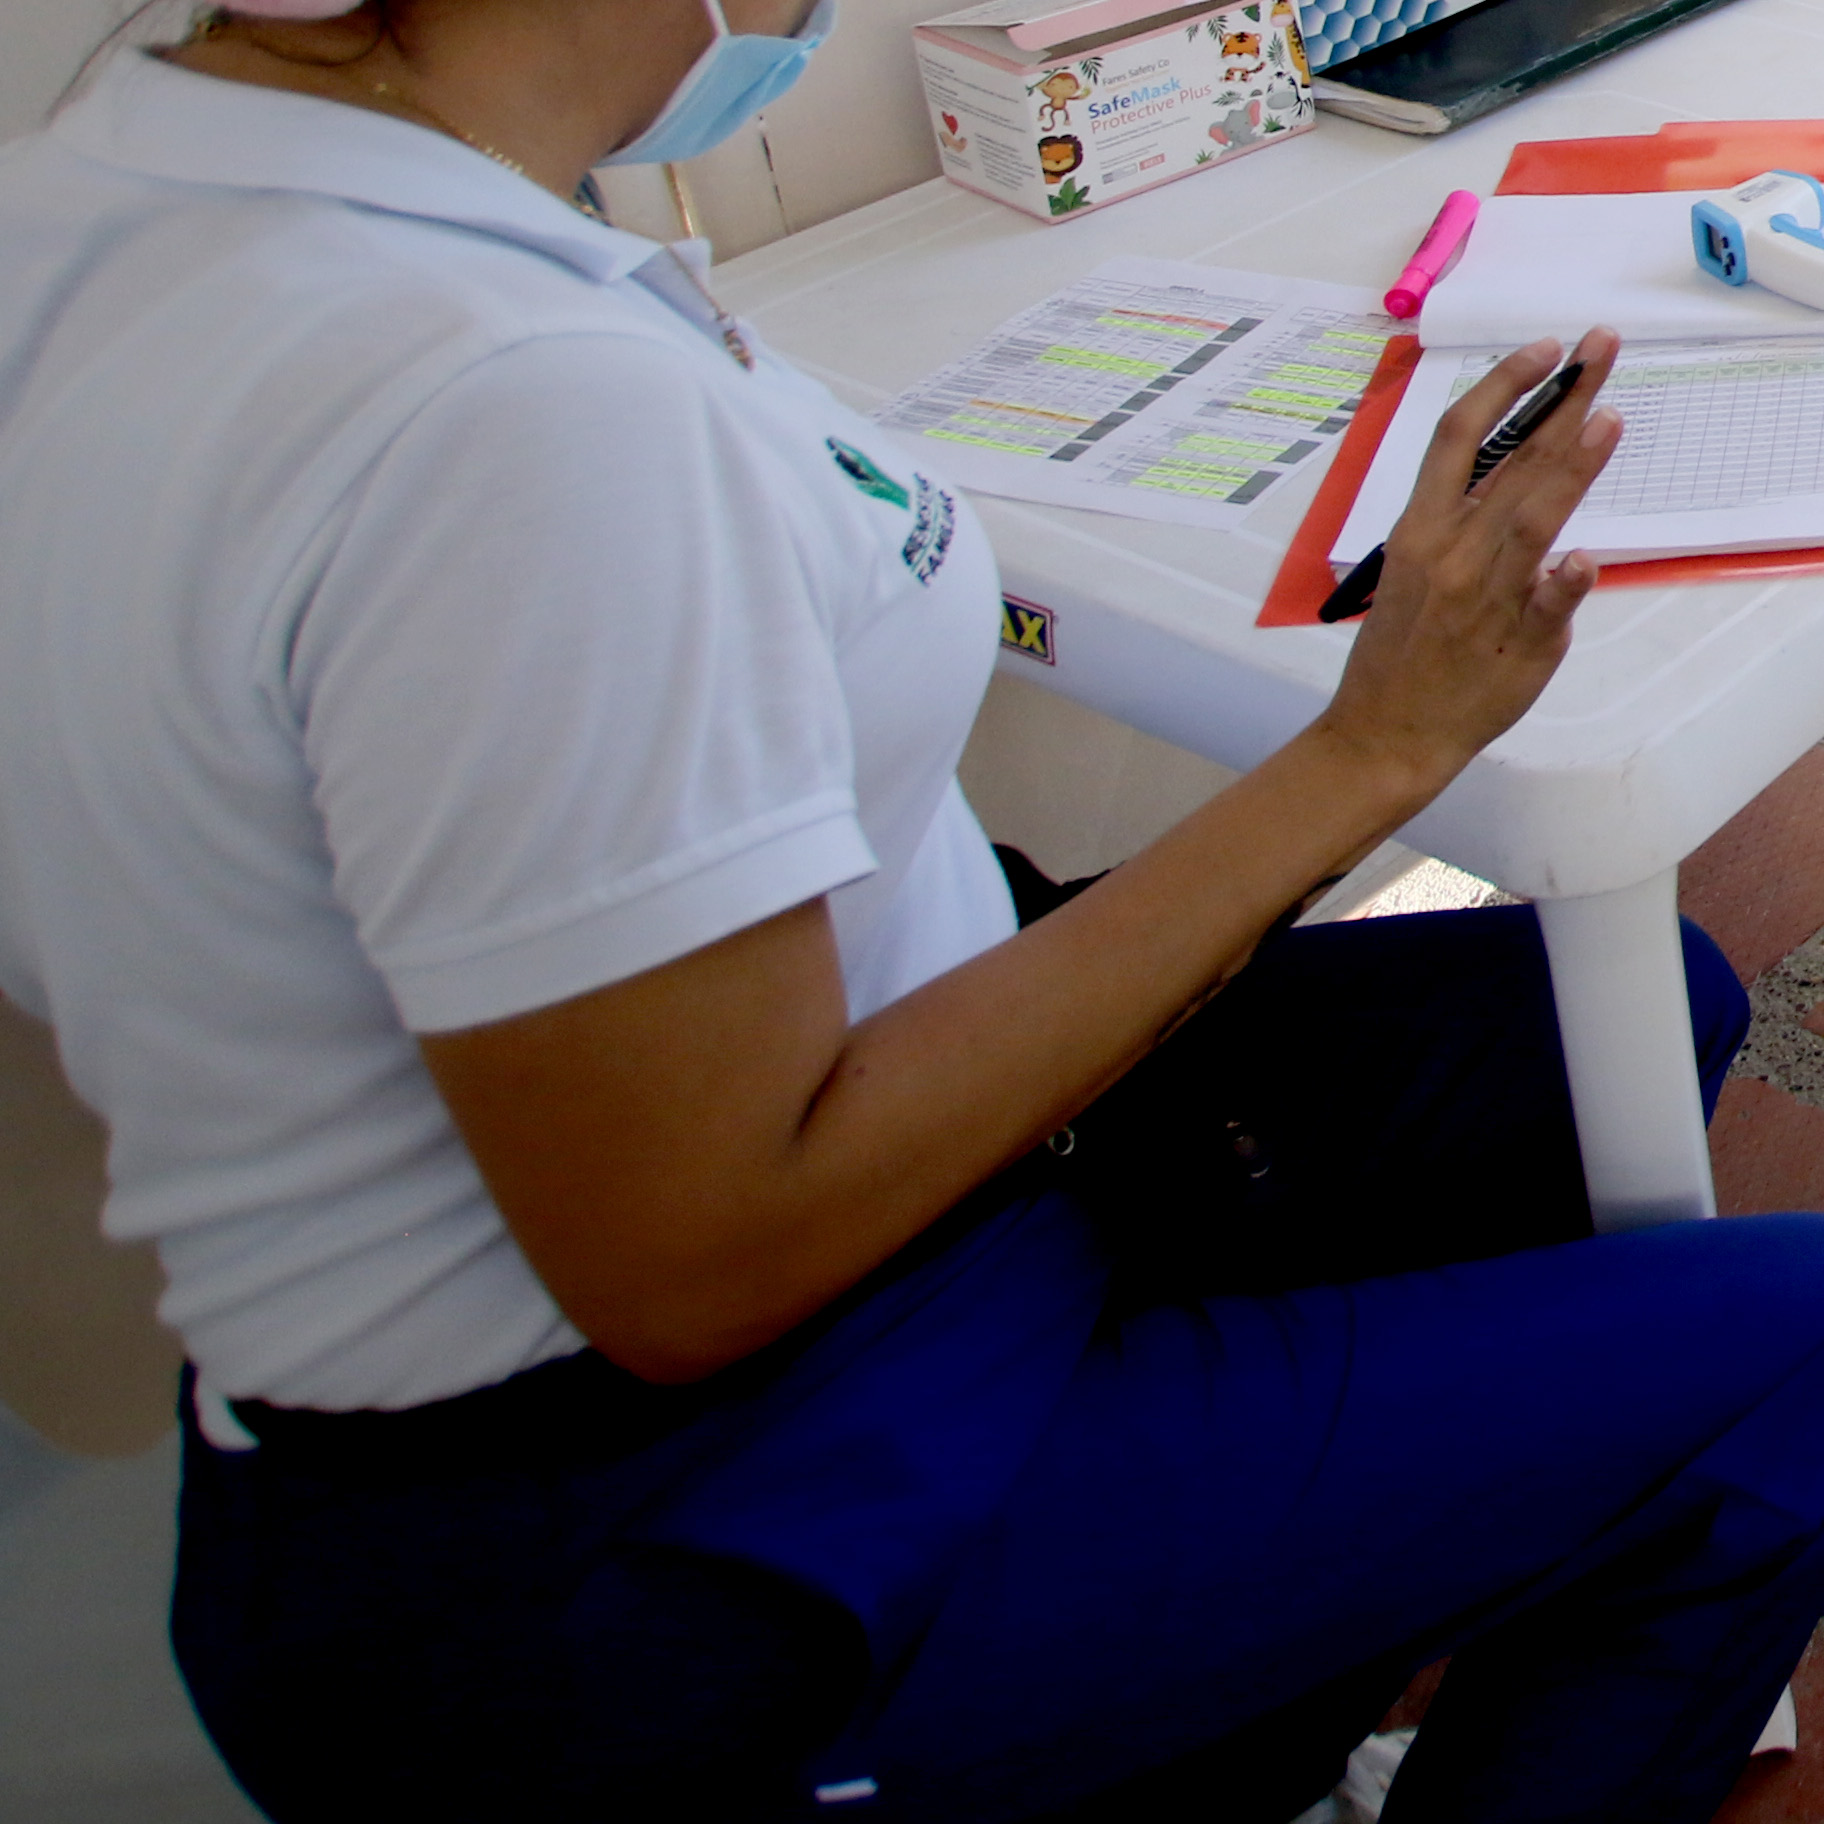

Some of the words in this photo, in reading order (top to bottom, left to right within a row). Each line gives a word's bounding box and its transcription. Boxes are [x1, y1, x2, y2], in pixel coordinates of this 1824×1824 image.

[1102, 73, 1127, 86] Fares
[1128, 63, 1156, 78] Safety
[1158, 59, 1170, 68] Co
[1088, 77, 1183, 120] SafeMask
[1090, 98, 1175, 134] Protective
[1179, 85, 1212, 104] Plus
